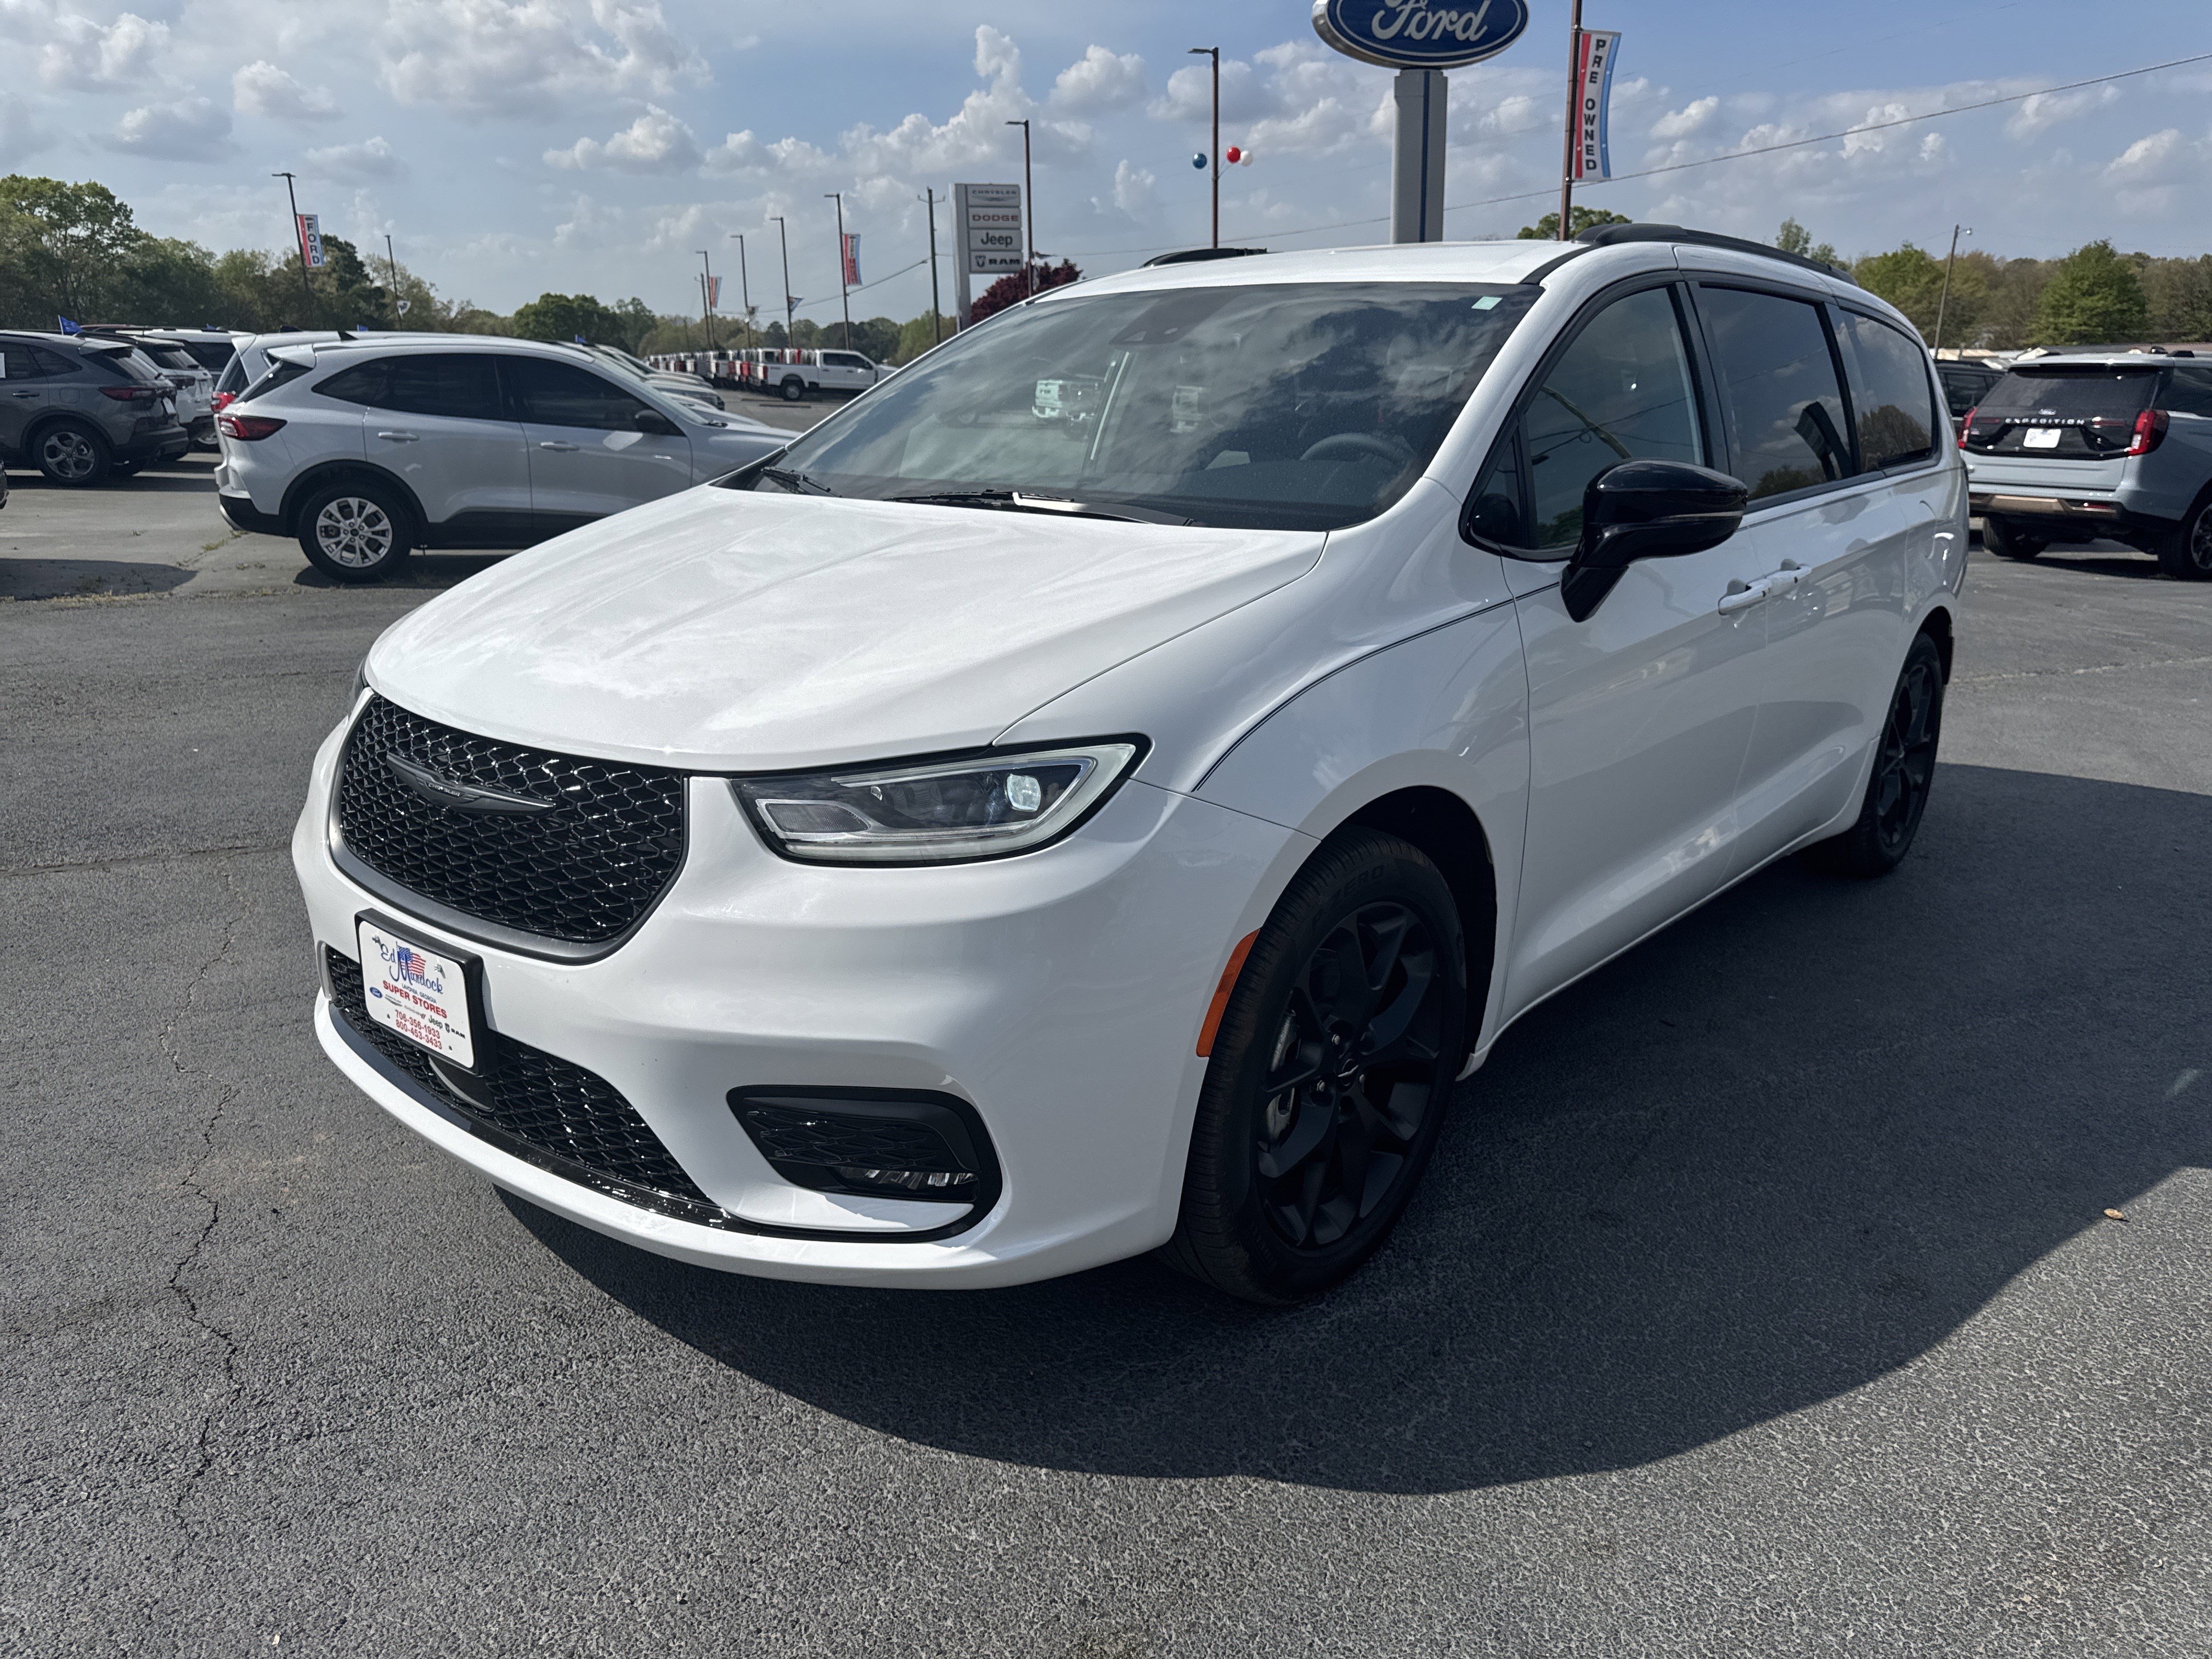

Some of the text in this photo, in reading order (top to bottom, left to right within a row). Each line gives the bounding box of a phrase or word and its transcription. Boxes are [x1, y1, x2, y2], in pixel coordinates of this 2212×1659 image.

[1372, 0, 1491, 41] Ford
[1583, 38, 1606, 171] PRE OWNED
[307, 222, 320, 264] FORD
[980, 232, 1014, 247] Jeep
[2005, 417, 2086, 425] EXPEDITION
[428, 783, 461, 797] CHRYSLER
[381, 943, 396, 963] Ed
[389, 949, 444, 995] Murdock
[382, 980, 448, 1019] SUPER STORES
[396, 1019, 443, 1051] 800-453-3433
[428, 1015, 443, 1029] Jeep
